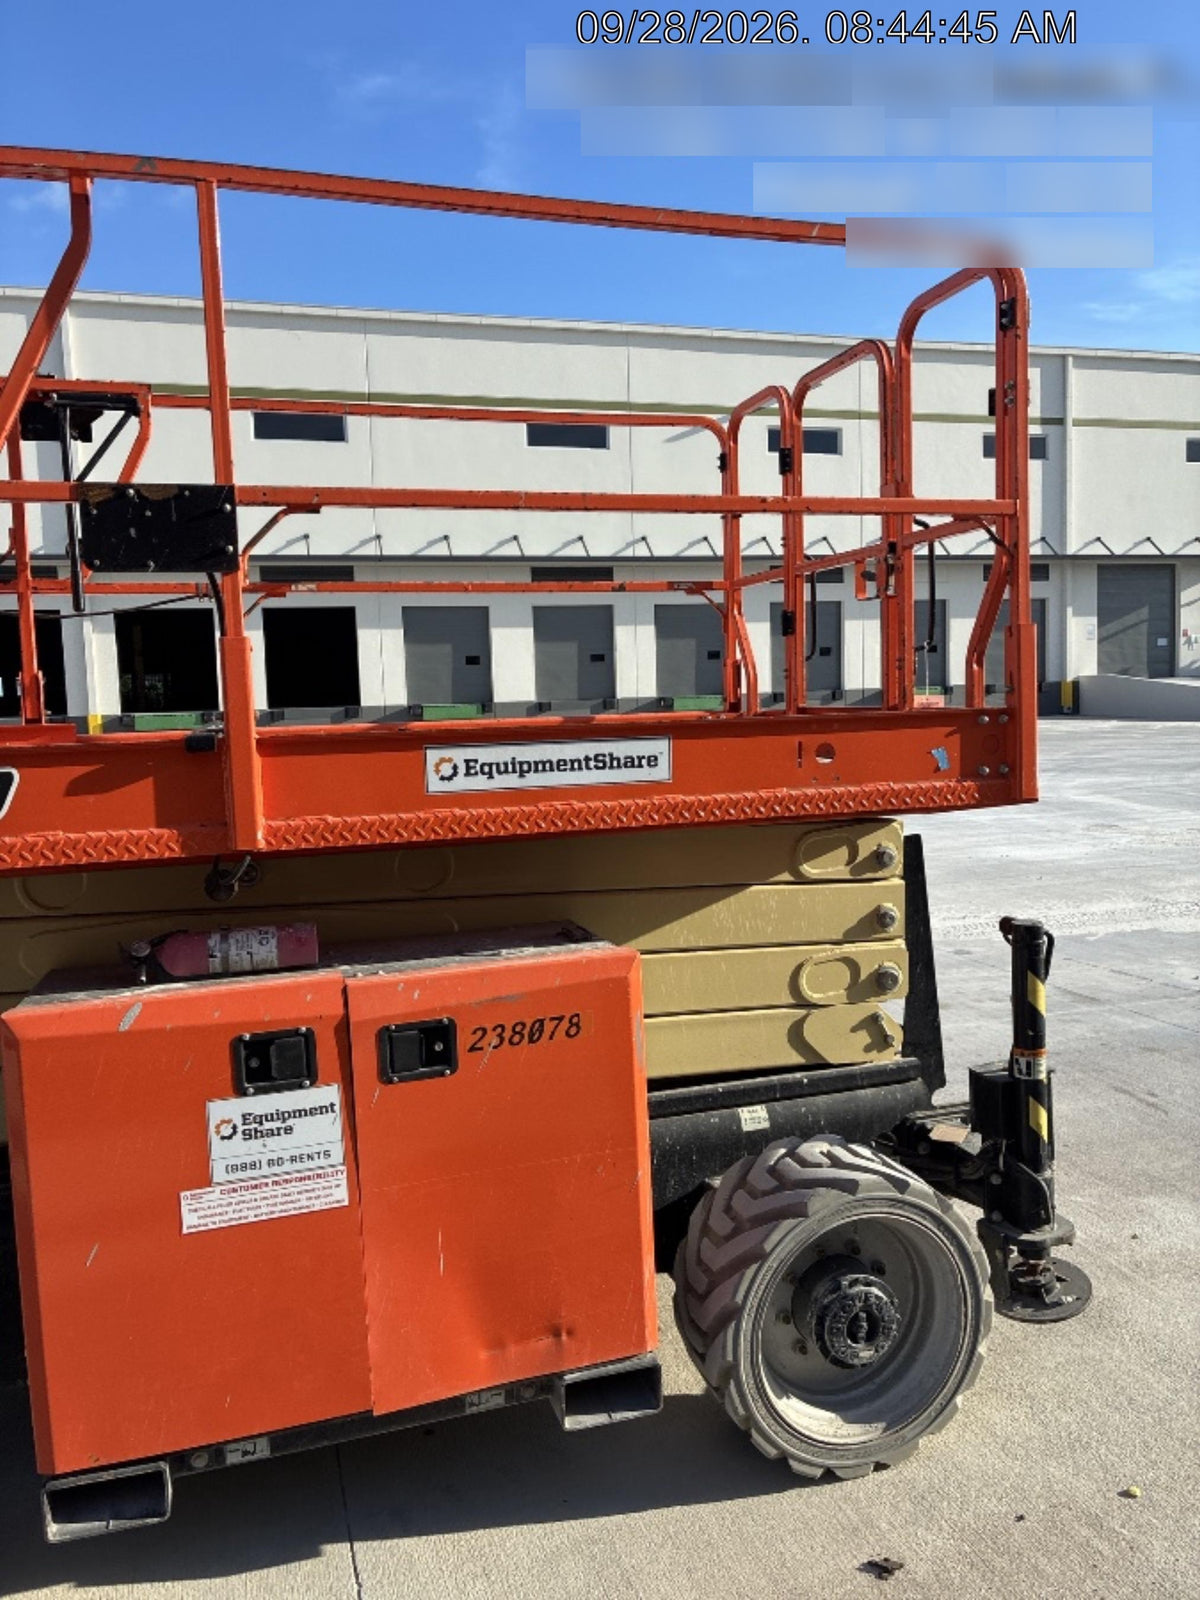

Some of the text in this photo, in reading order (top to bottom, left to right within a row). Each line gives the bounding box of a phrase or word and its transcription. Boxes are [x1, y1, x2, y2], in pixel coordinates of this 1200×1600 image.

[464, 752, 659, 780] EquipmentShare
[467, 1012, 581, 1053] 238078
[241, 1102, 336, 1126] Equipment
[241, 1125, 294, 1141] Share
[225, 1159, 261, 1174] (888)
